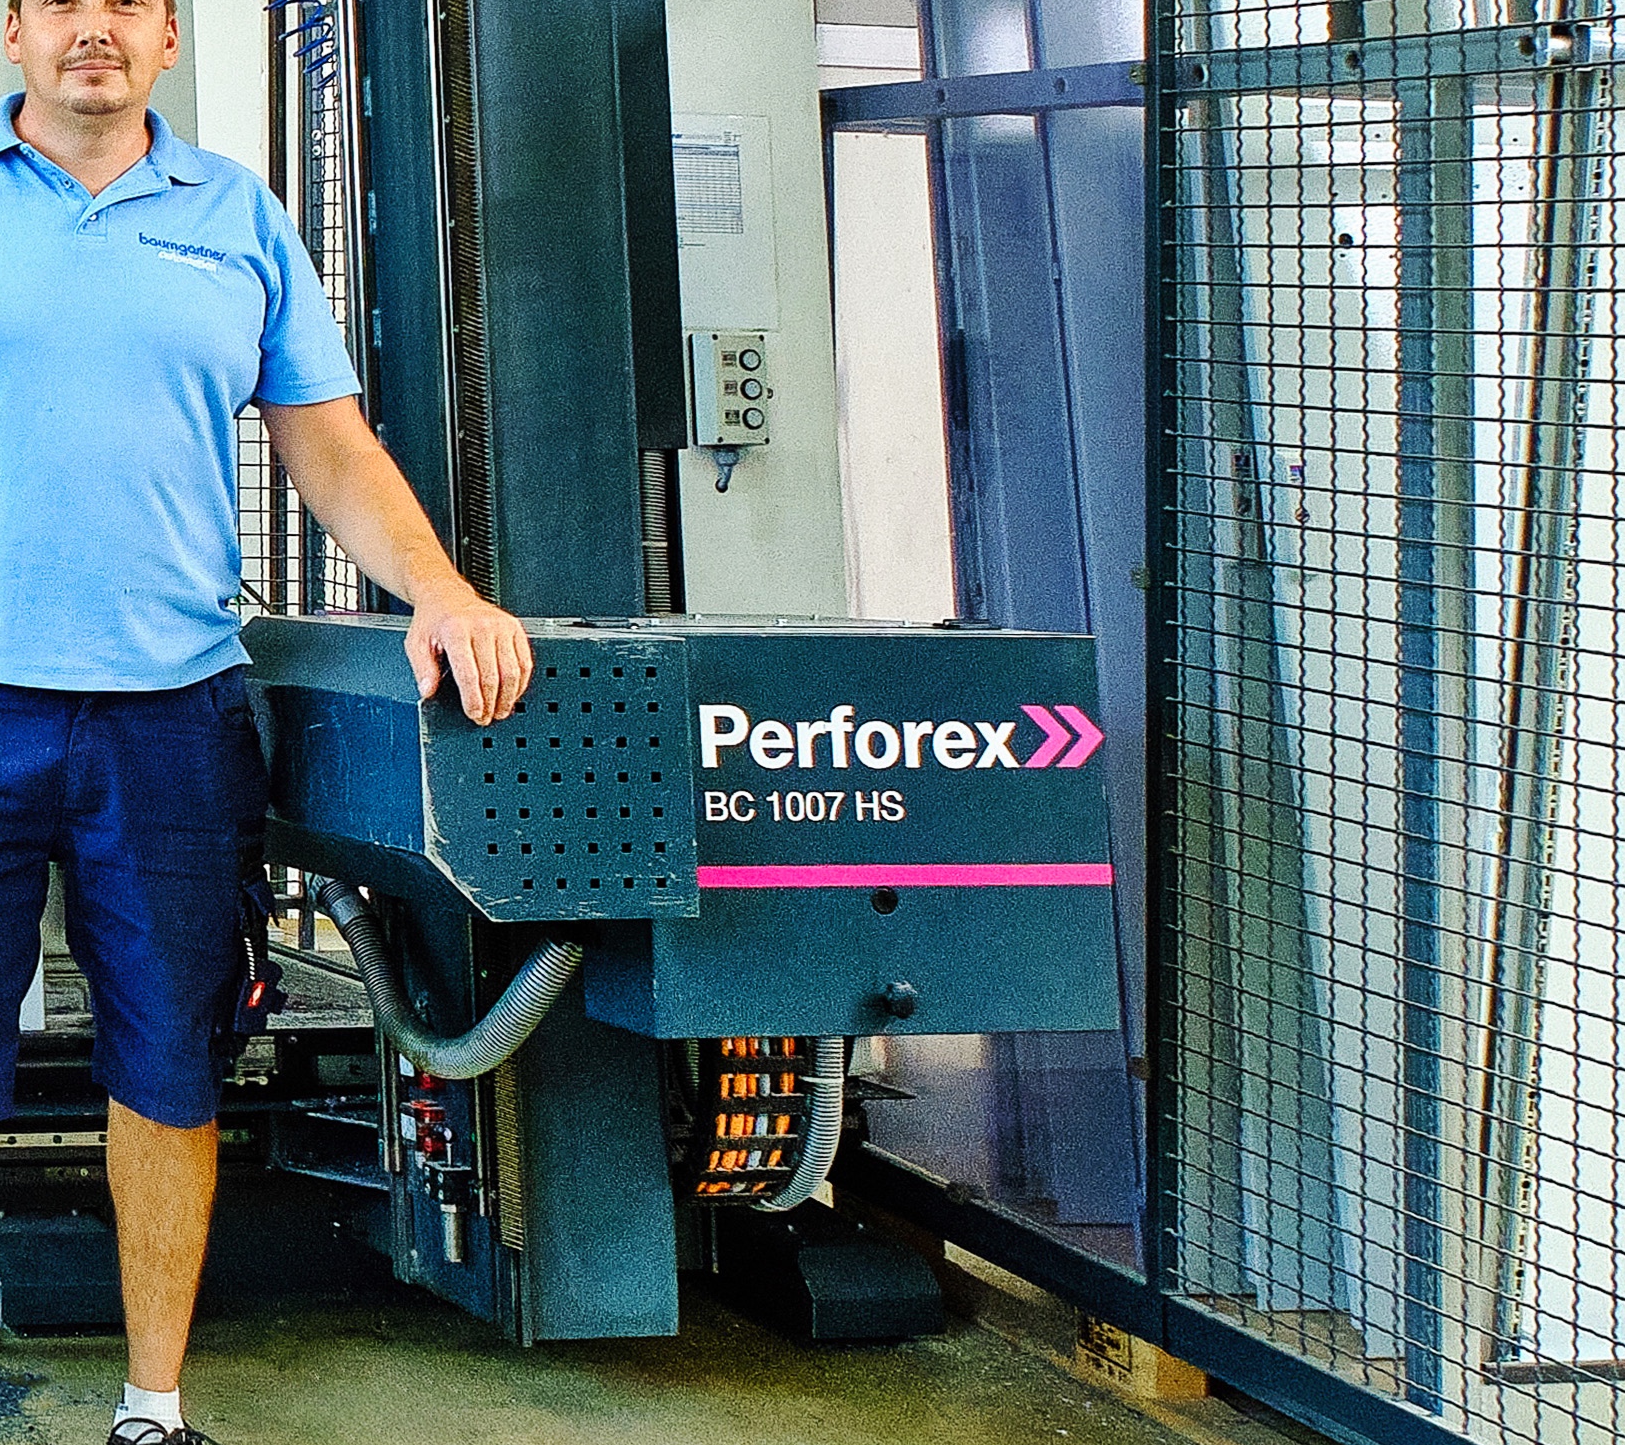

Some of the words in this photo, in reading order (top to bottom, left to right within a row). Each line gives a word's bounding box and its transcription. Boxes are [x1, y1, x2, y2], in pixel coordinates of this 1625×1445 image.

[139, 232, 226, 262] baumgartner
[698, 704, 1021, 769] Perforex
[704, 791, 756, 821] BC
[766, 791, 845, 821] 1007
[855, 791, 907, 821] HS
